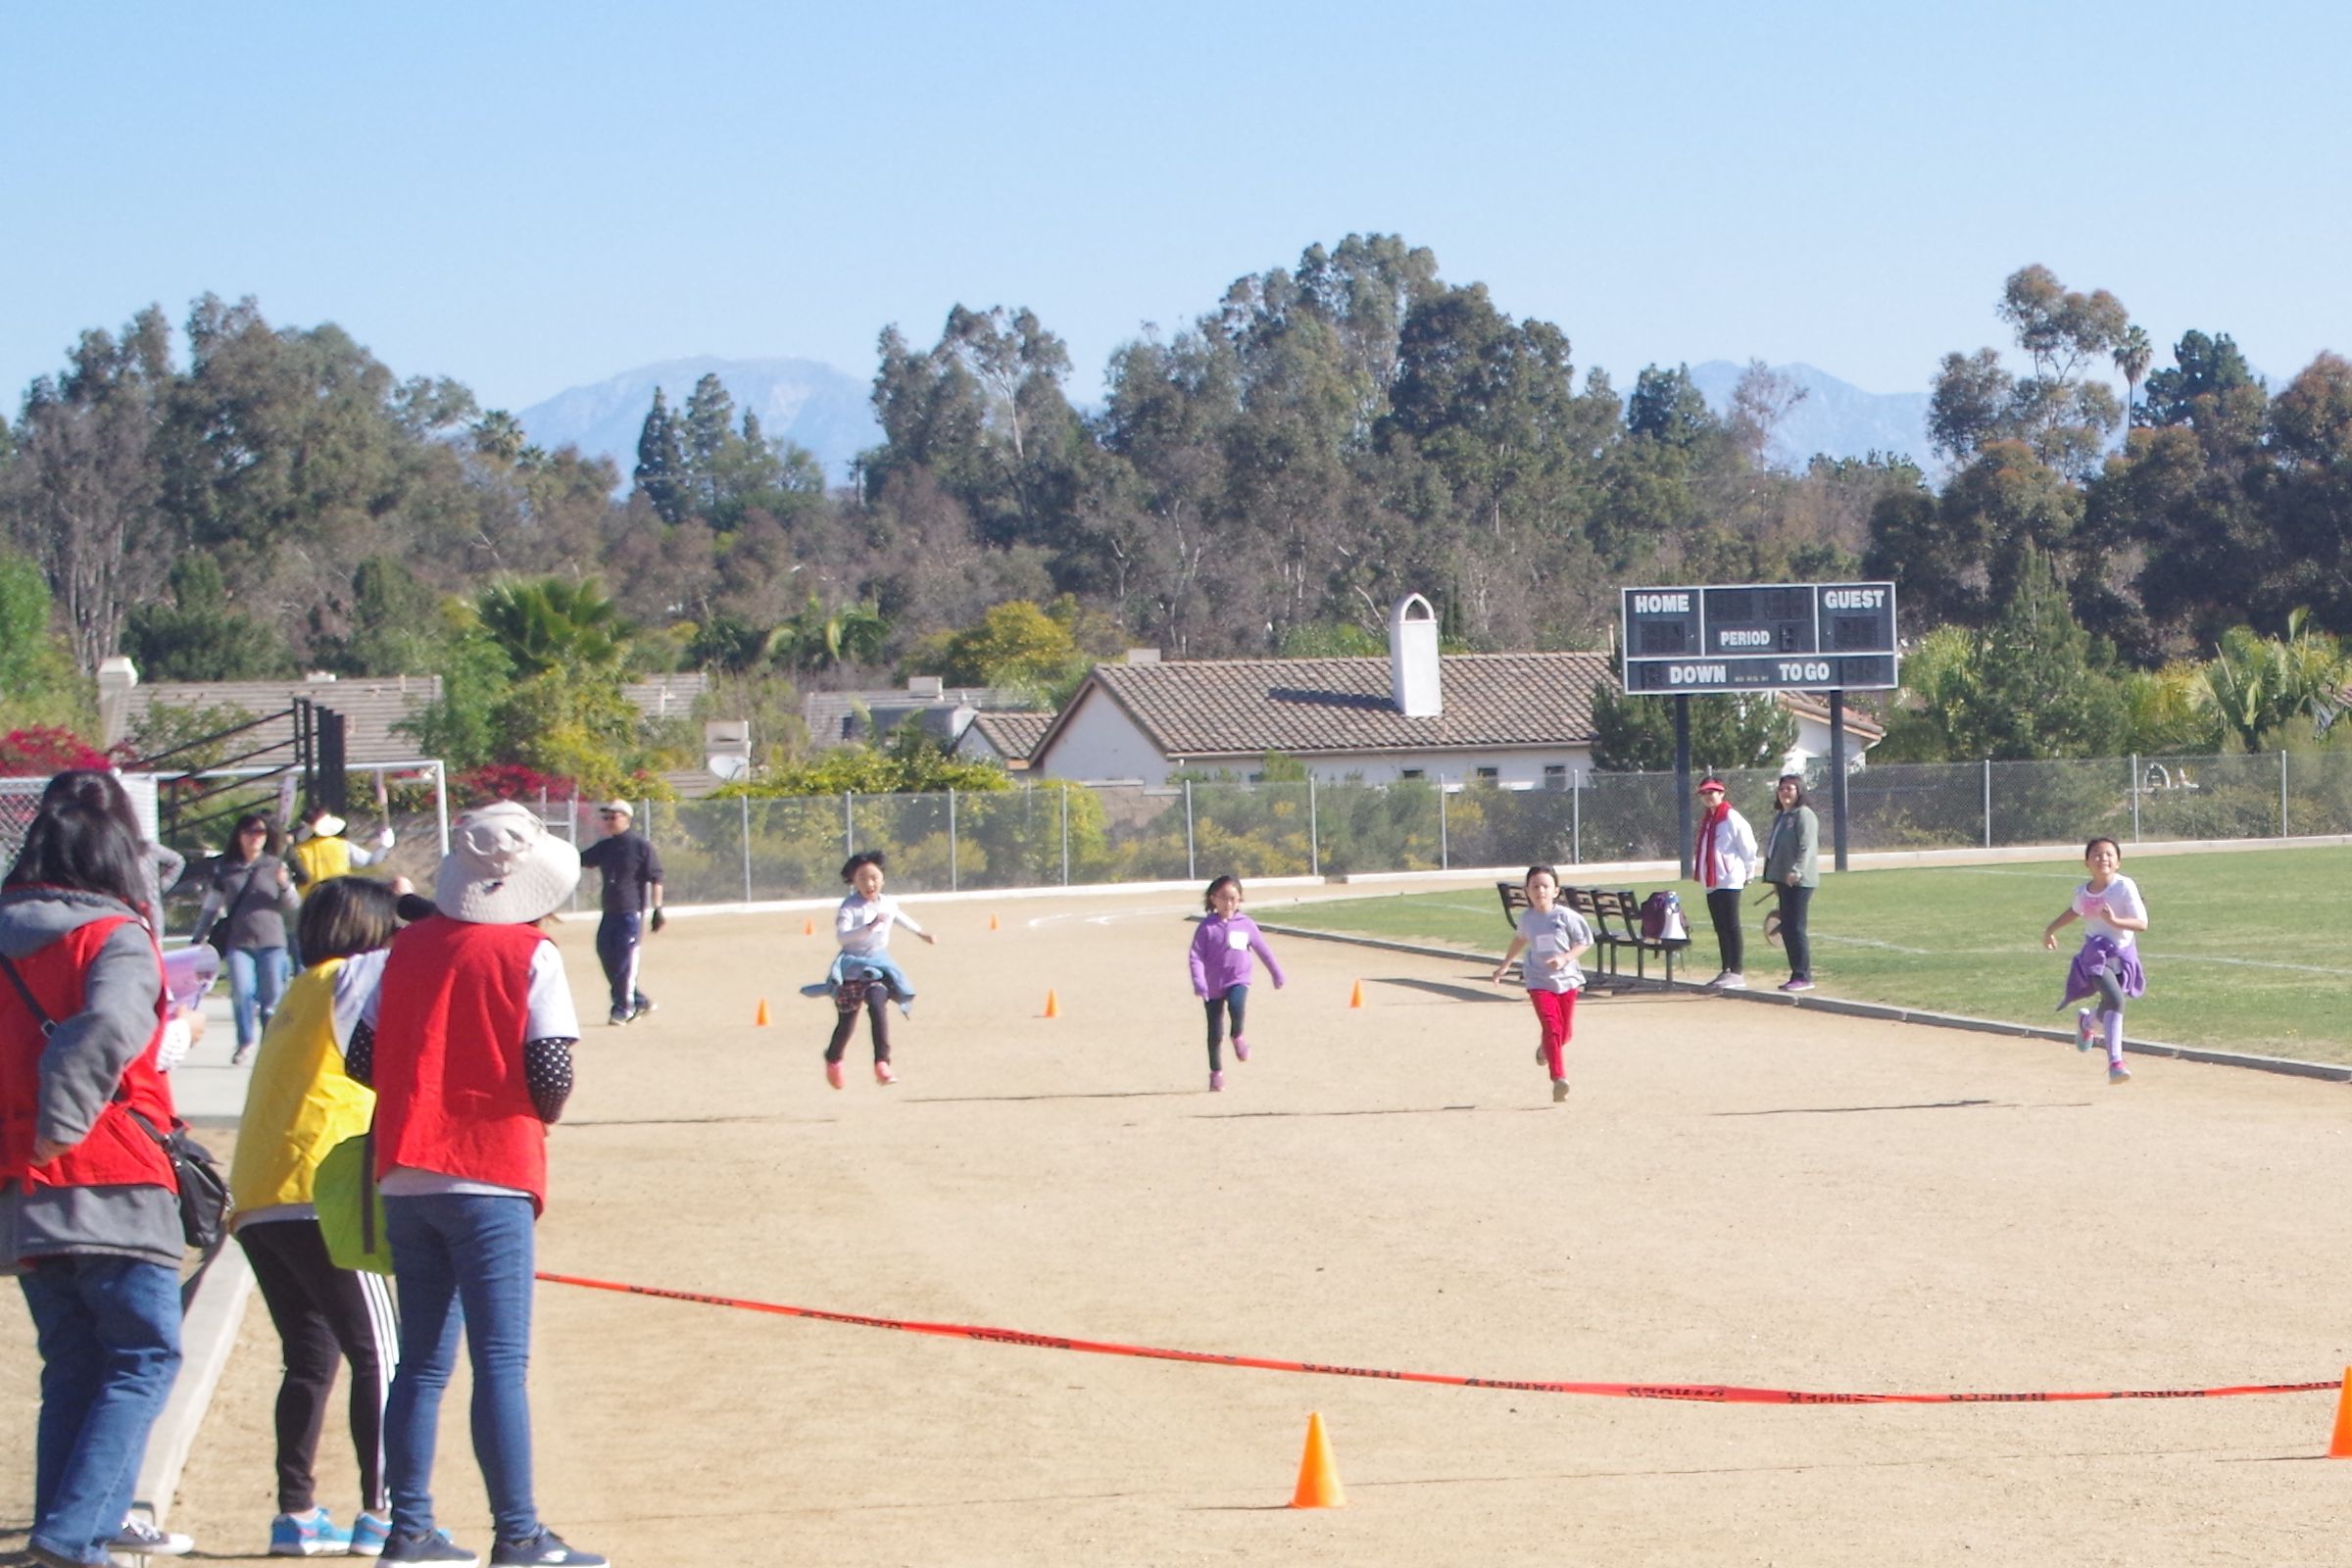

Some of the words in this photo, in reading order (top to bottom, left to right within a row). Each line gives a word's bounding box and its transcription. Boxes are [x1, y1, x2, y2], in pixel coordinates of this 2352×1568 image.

[1635, 594, 1690, 613] HOME
[1825, 590, 1885, 609] GUEST
[1720, 630, 1770, 646] PERIOD
[1670, 665, 1727, 683] DOWN
[1779, 663, 1802, 681] TO
[1804, 662, 1830, 680] GO
